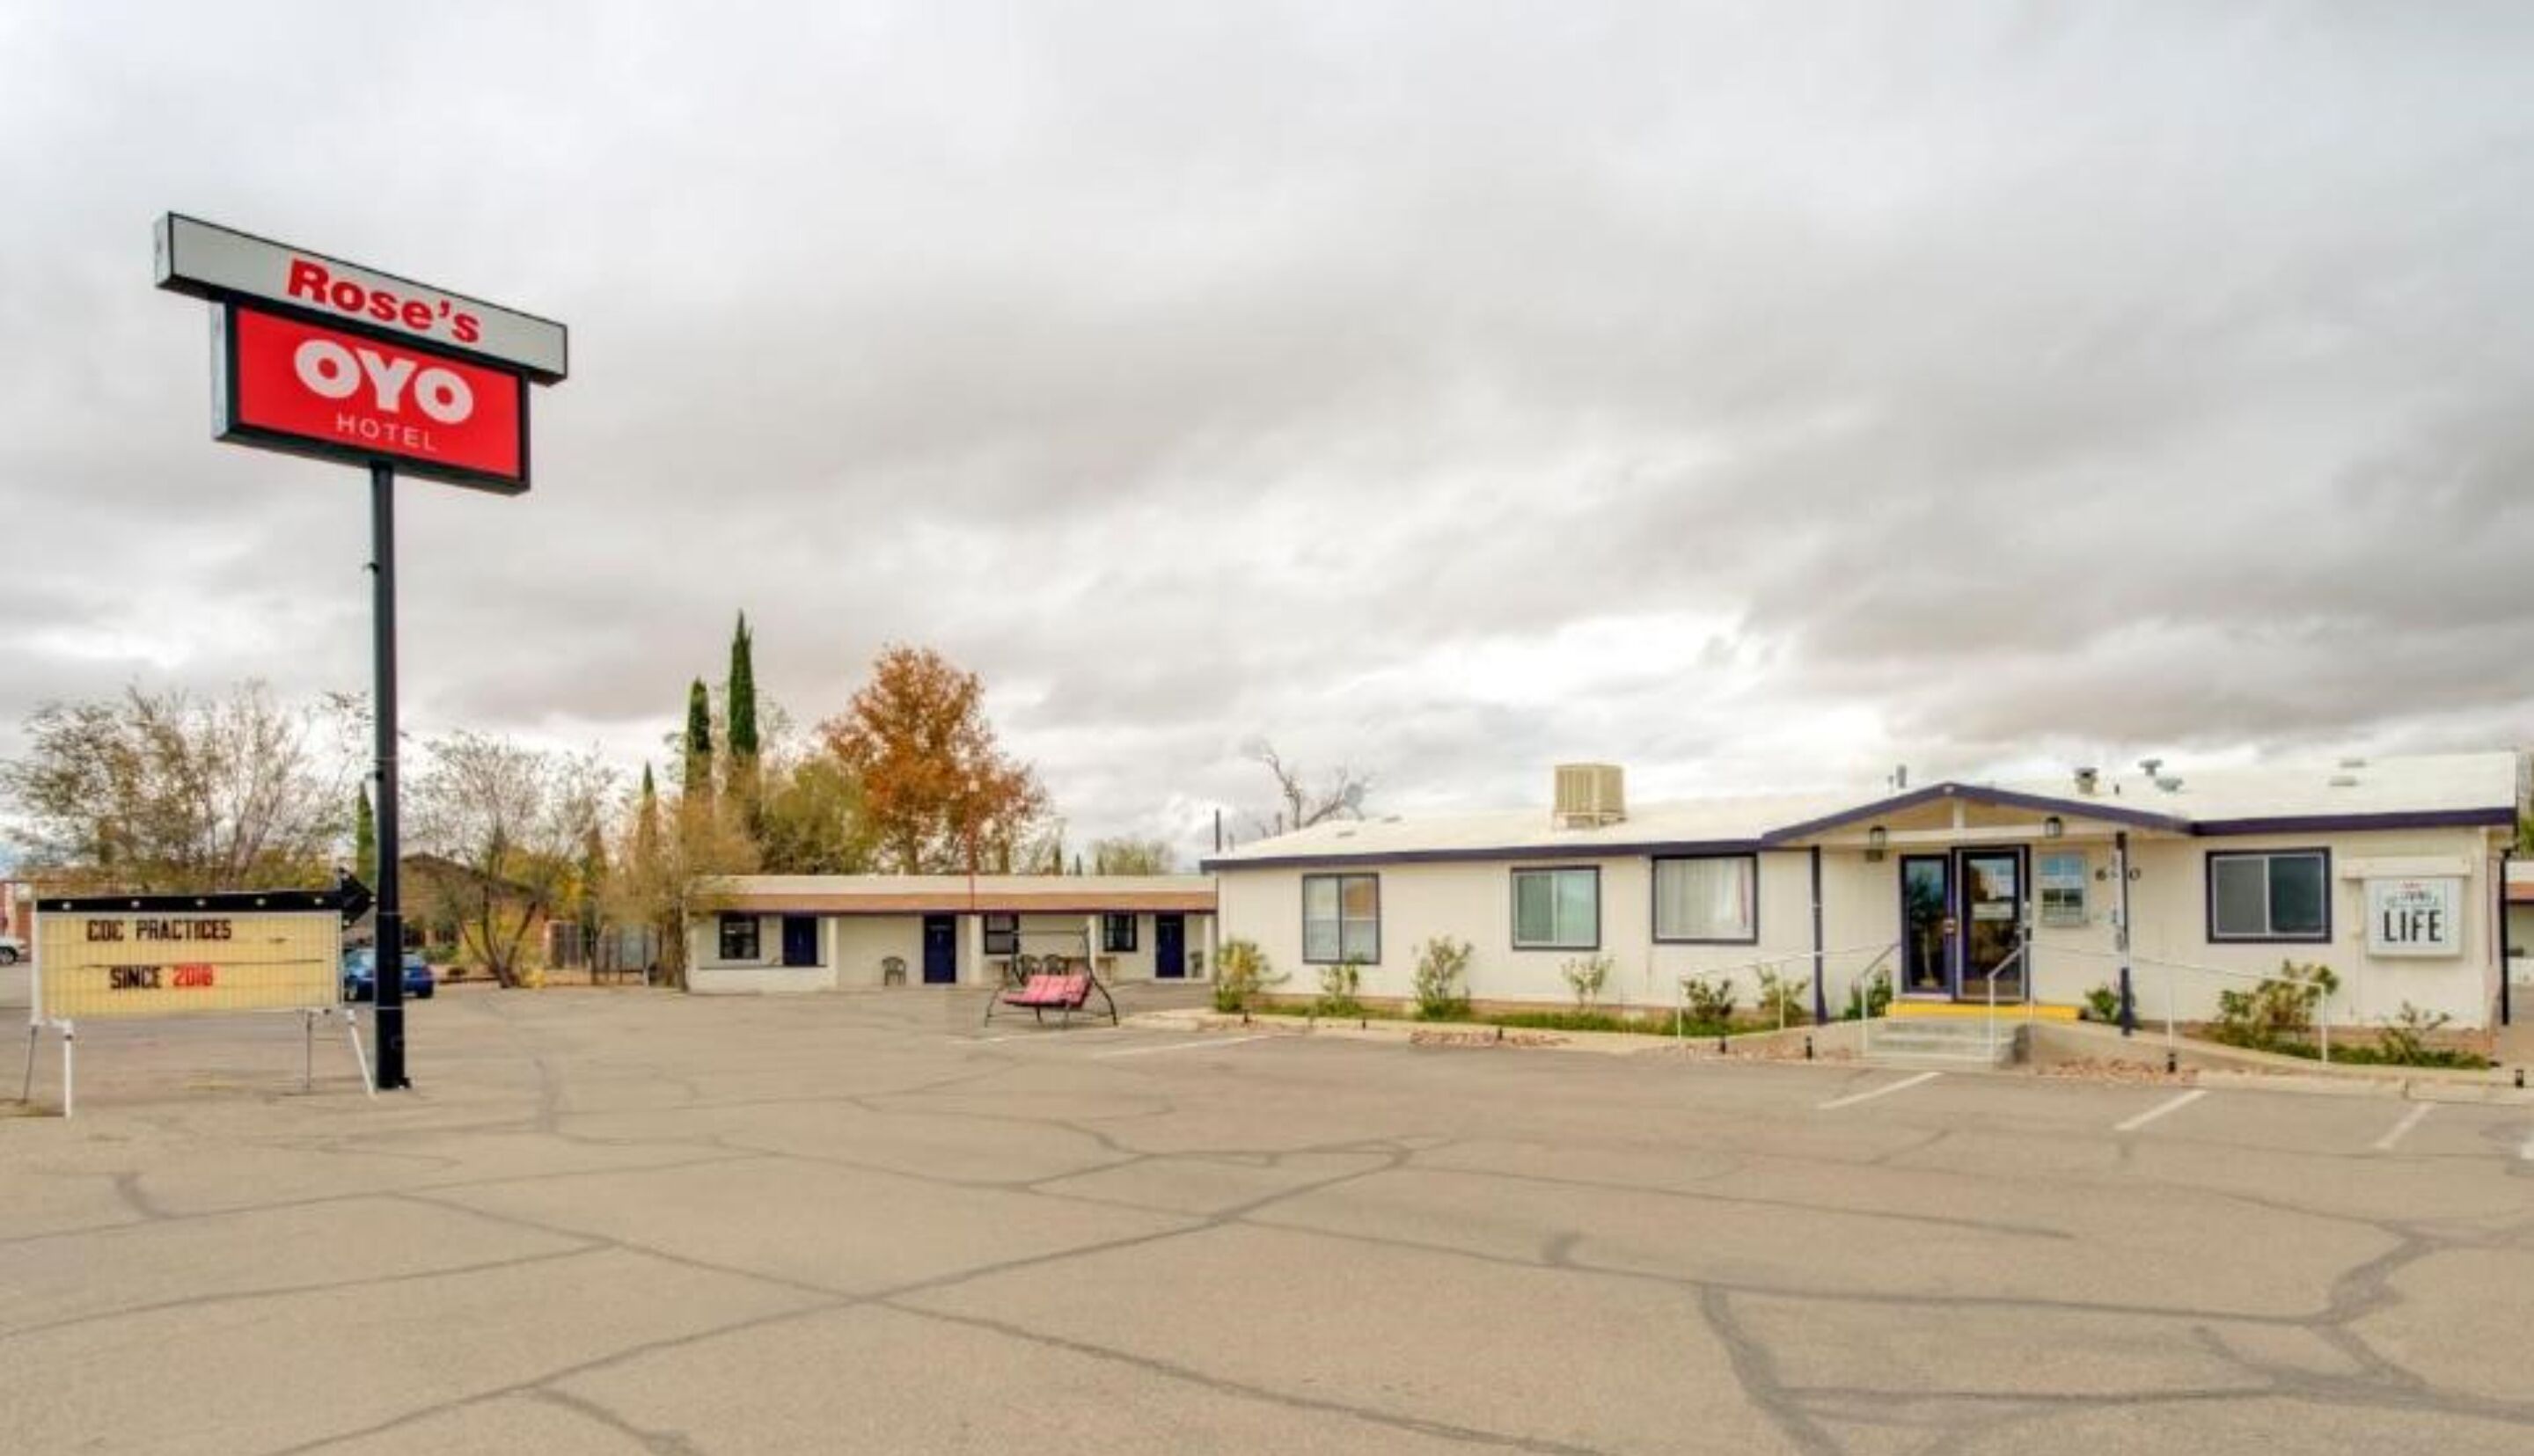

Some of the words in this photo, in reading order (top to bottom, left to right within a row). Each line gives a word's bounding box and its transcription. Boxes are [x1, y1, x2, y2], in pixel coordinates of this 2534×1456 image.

[289, 259, 480, 343] Rose's
[294, 340, 474, 424] OYO
[337, 413, 436, 451] HOTEL
[87, 919, 124, 941] CDC
[136, 918, 231, 941] PRACTICES
[2384, 910, 2442, 941] LIFE
[110, 965, 161, 990] SINCE
